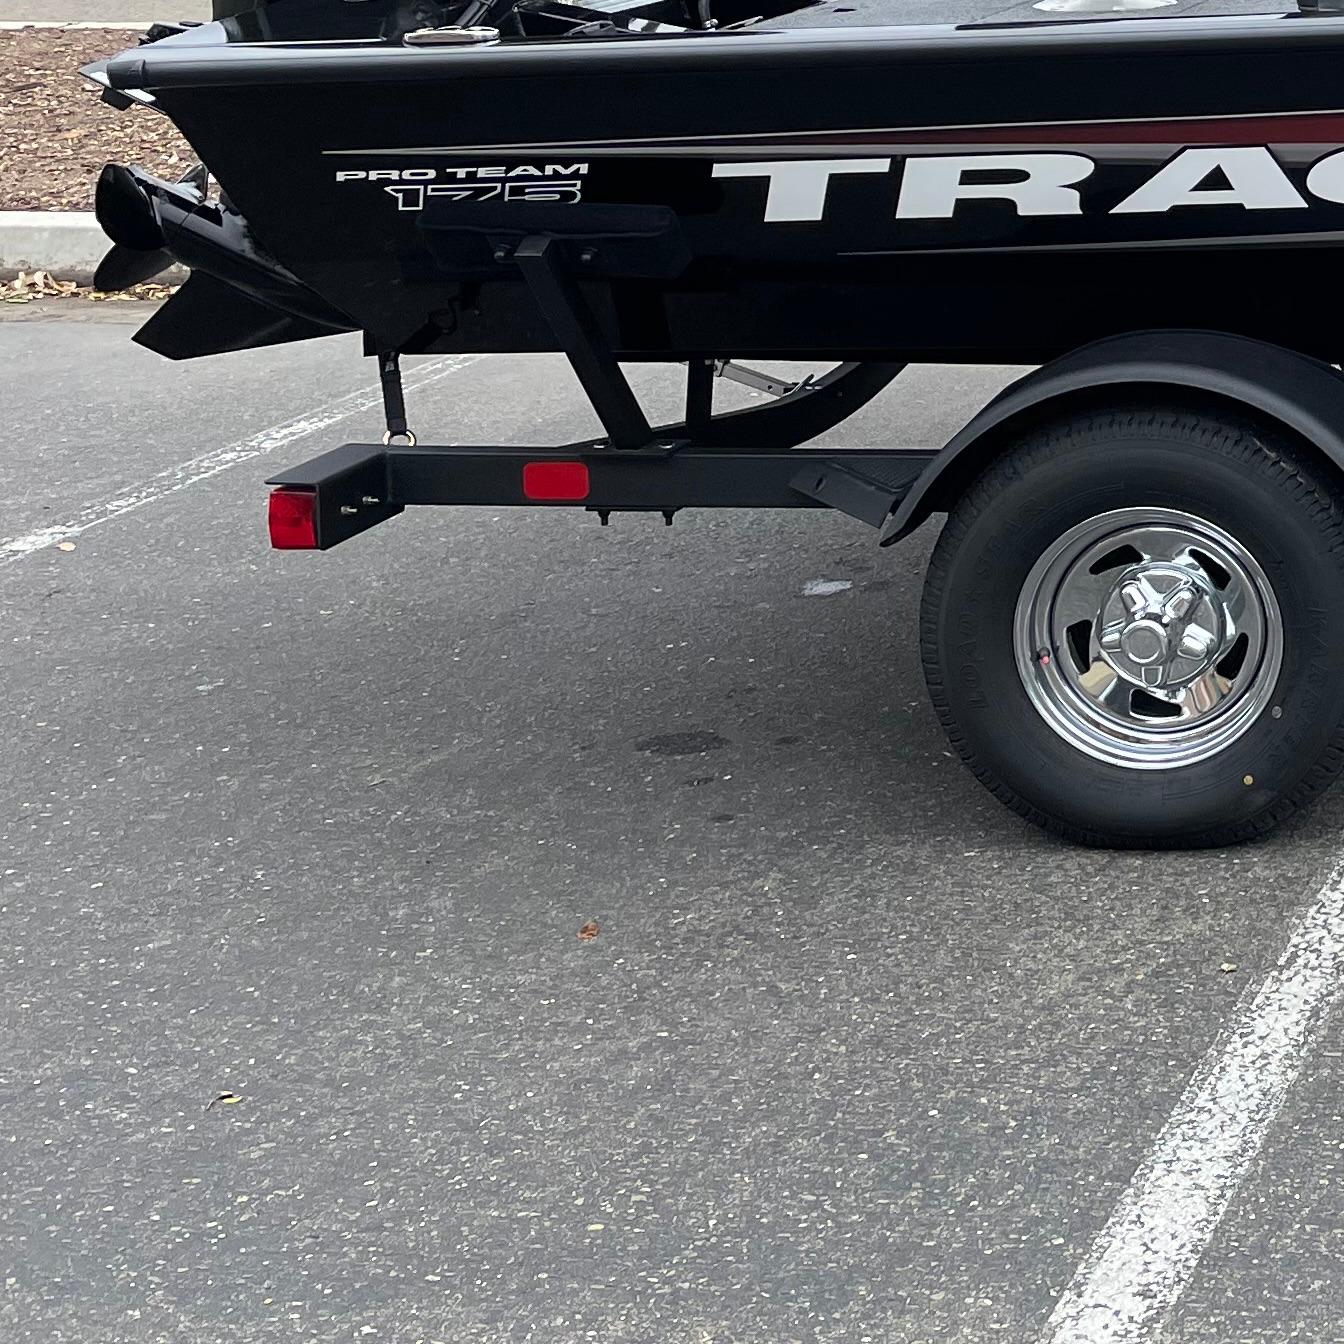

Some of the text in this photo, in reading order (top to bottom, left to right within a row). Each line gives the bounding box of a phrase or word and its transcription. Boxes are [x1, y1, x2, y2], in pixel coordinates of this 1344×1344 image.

[336, 163, 589, 182] PRO TEAM
[384, 181, 581, 211] 175
